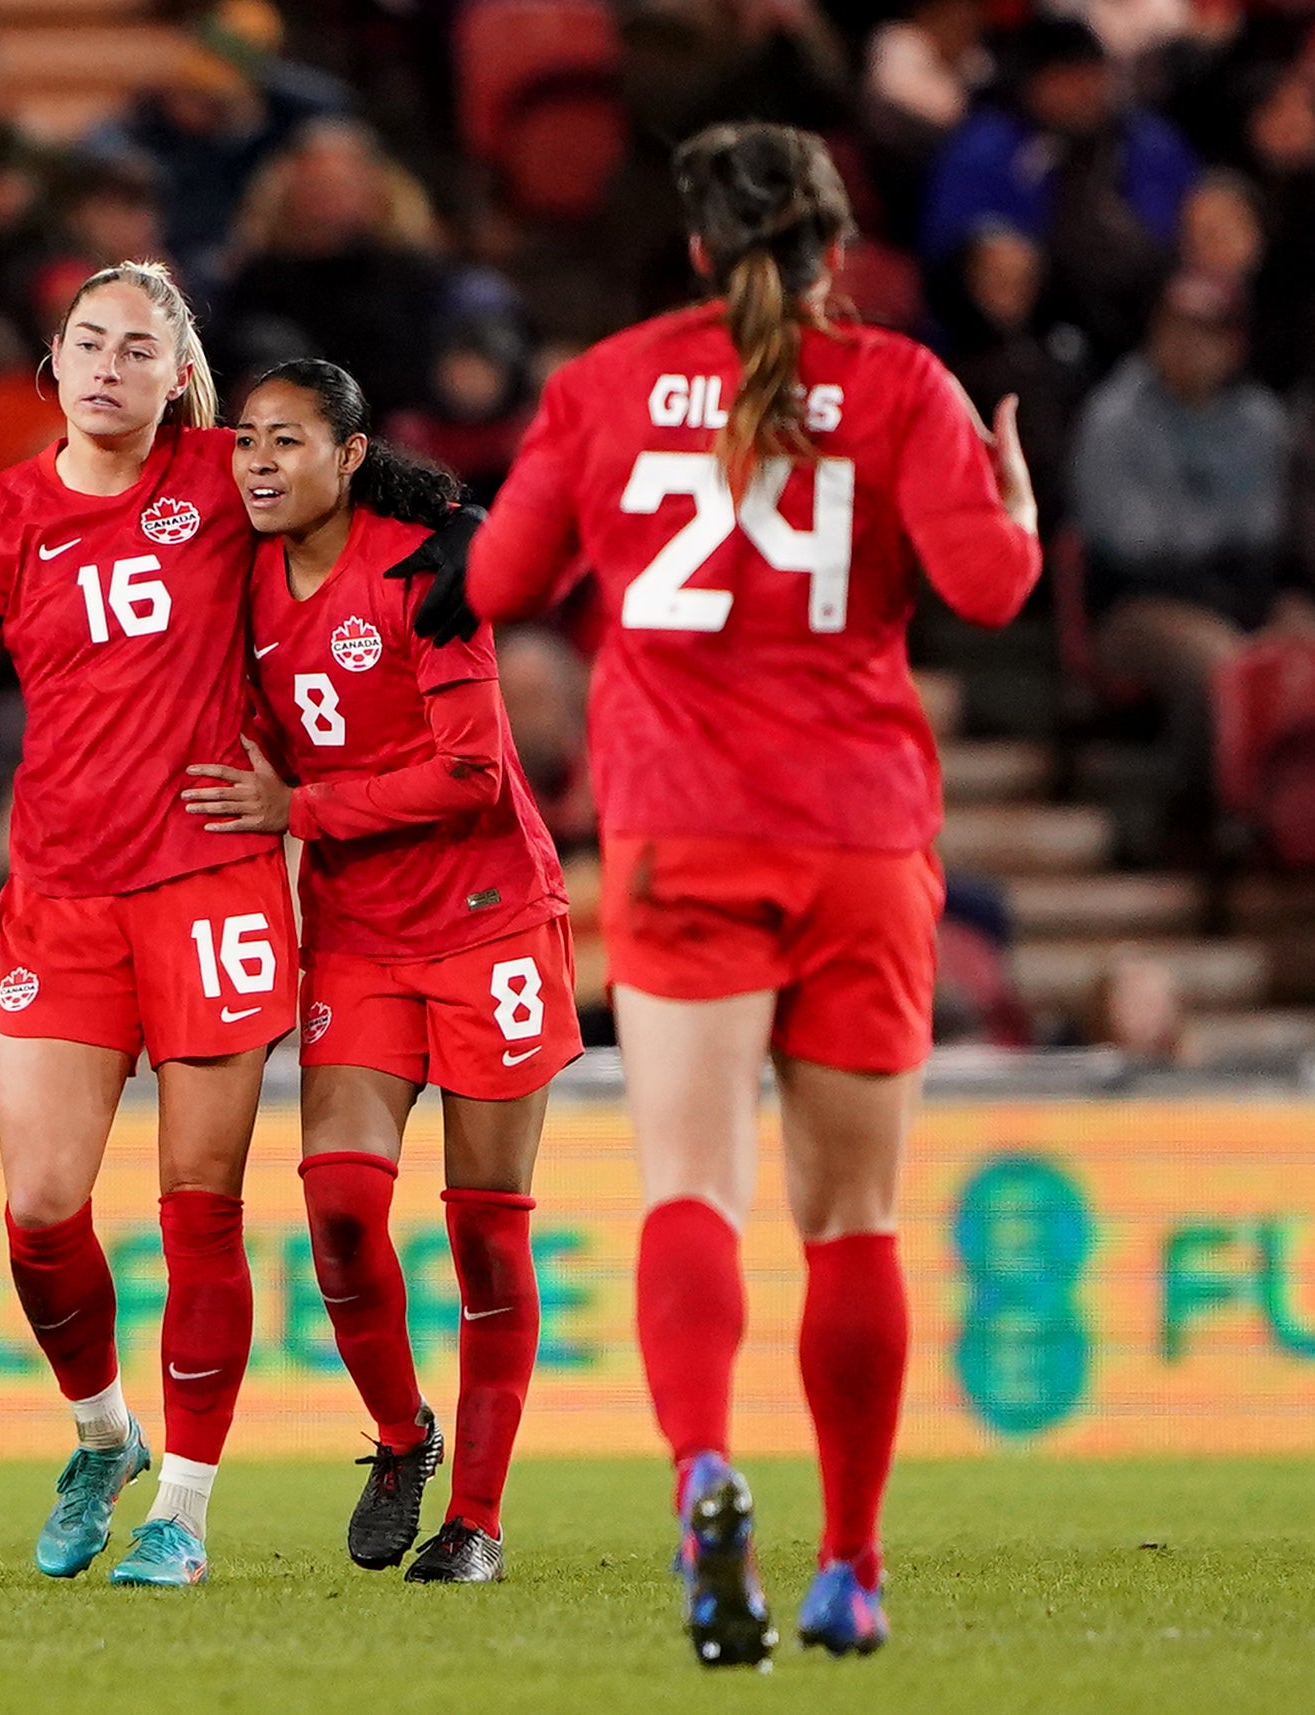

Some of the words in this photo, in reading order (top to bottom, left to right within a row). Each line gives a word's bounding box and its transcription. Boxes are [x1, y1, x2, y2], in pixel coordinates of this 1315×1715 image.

[648, 374, 844, 432] GILS
[144, 513, 197, 531] CANADA
[620, 450, 856, 634] 24
[77, 554, 172, 644] 16
[333, 639, 379, 651] CANADA
[294, 672, 346, 746] 8
[0, 985, 36, 995] CANADA
[191, 912, 277, 998] 16
[490, 957, 544, 1041] 8
